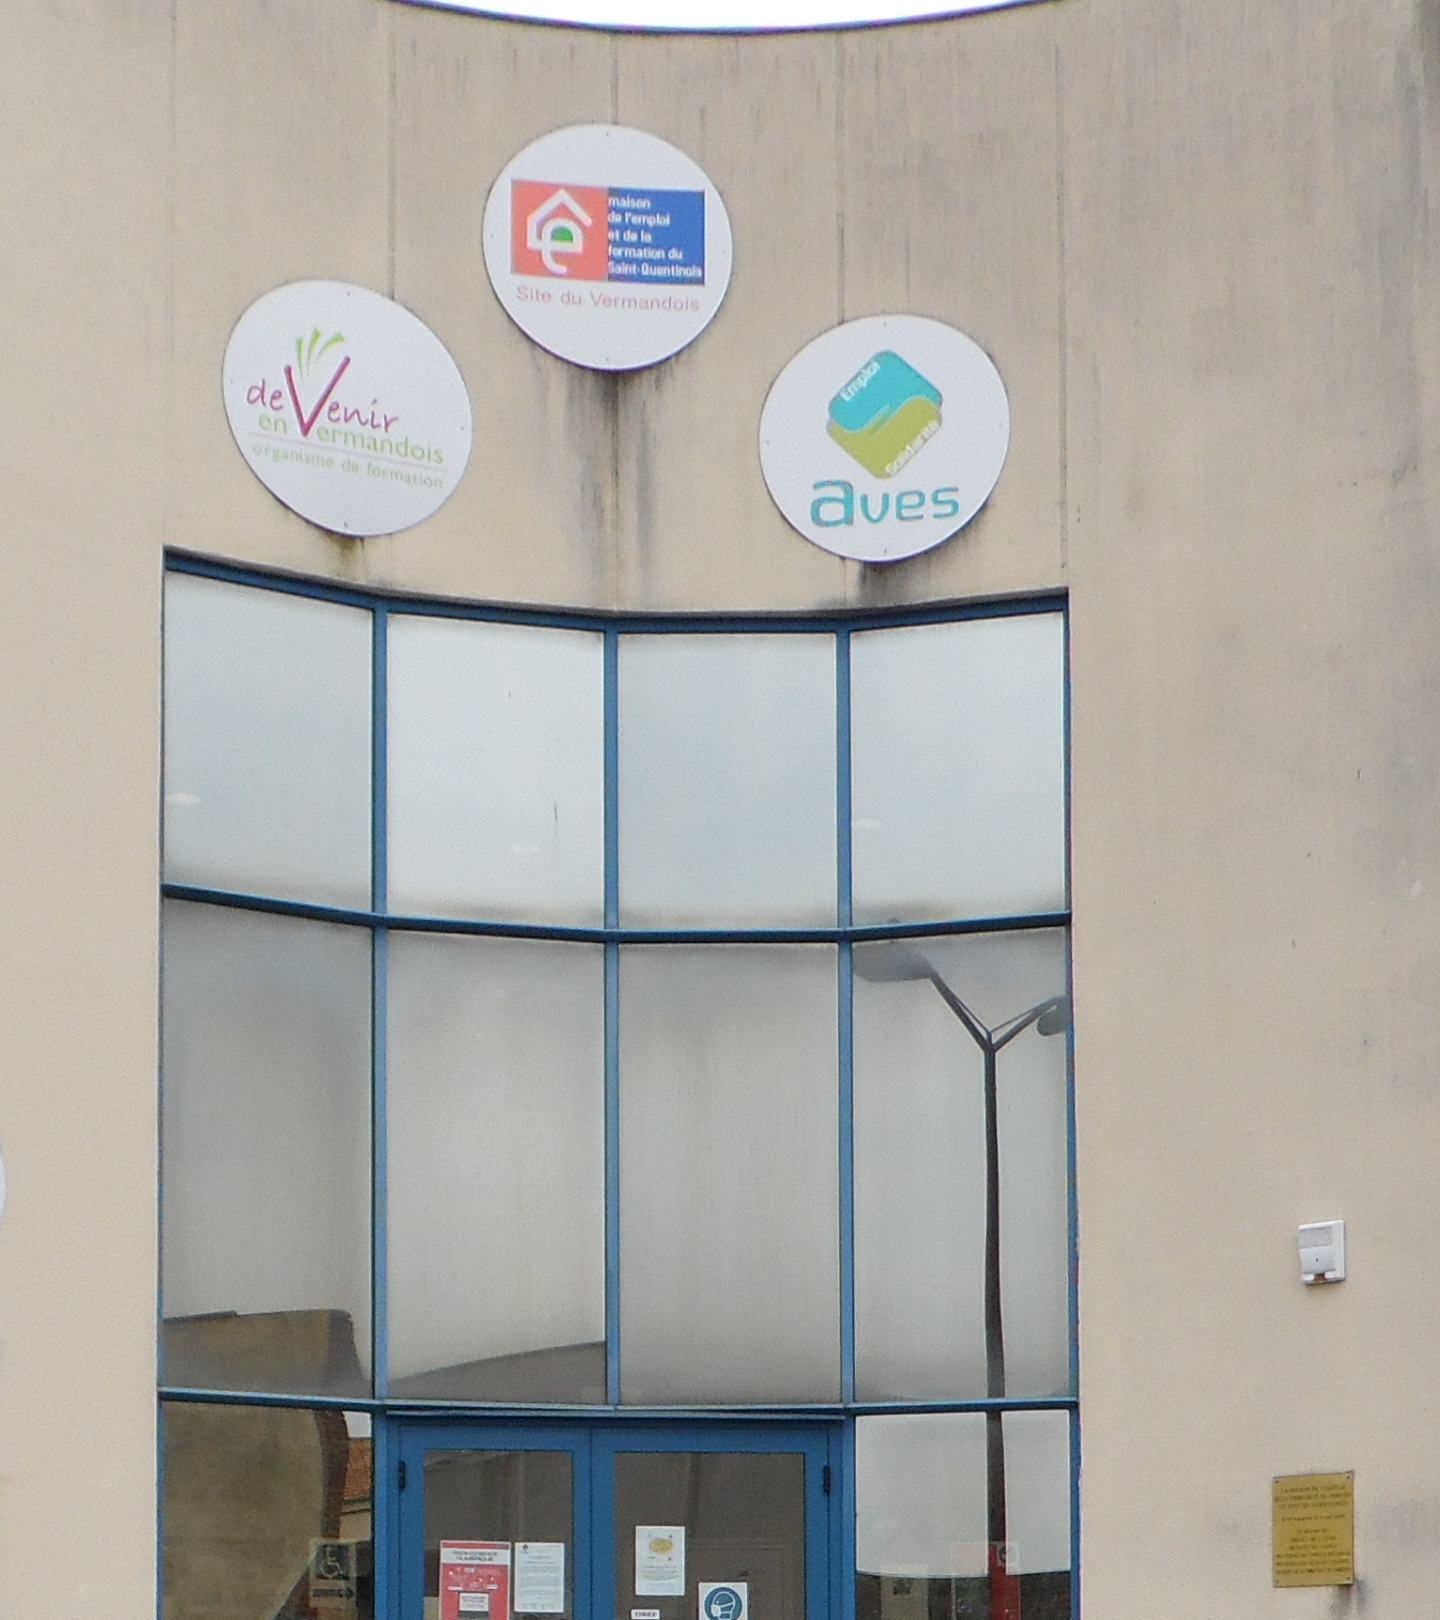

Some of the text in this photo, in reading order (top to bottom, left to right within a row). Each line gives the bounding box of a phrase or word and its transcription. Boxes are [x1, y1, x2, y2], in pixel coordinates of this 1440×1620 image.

[608, 195, 651, 208] maison
[607, 212, 670, 227] de l'emploi
[623, 231, 637, 241] de
[608, 246, 683, 260] formation du
[516, 285, 700, 312] Site du Vermandois
[840, 361, 881, 401] Emploi
[258, 414, 288, 434] en
[252, 444, 444, 490] organisme de formation
[810, 479, 960, 528] aves
